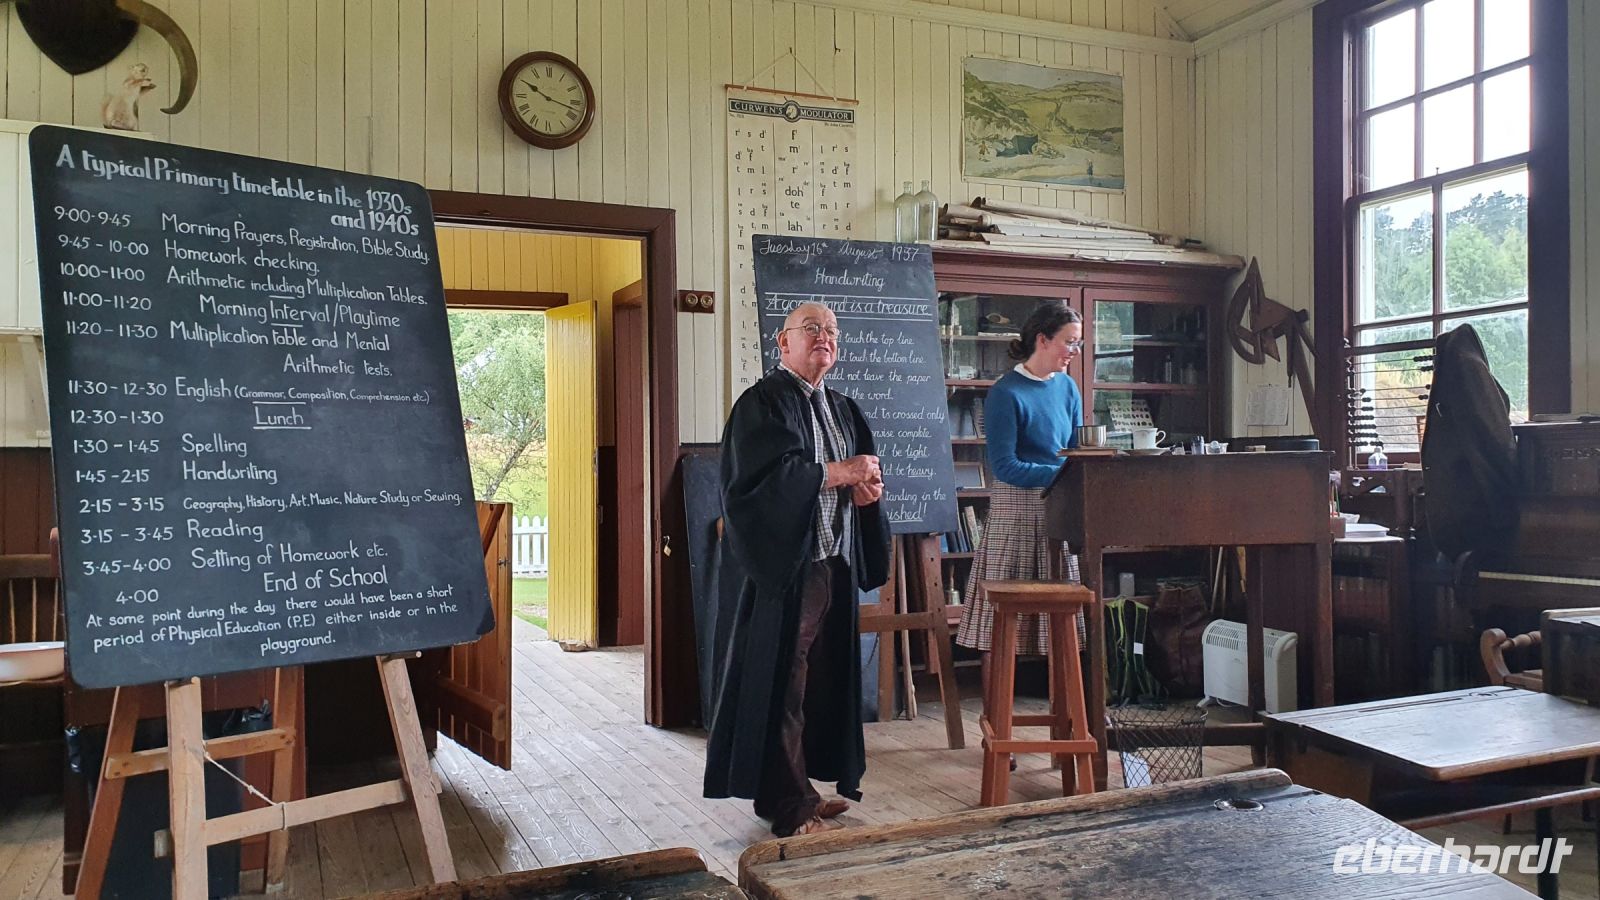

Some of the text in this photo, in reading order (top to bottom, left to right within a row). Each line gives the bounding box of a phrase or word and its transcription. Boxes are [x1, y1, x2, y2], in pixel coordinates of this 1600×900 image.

[735, 102, 848, 120] CURWEN'S MODULATOR
[56, 144, 413, 215] A typical Primary timetable in the 1930s
[331, 210, 419, 235] and 1940s
[787, 220, 803, 232] lah
[162, 212, 231, 243] Morning
[234, 221, 287, 247] Prayers,
[289, 228, 359, 254] Registration,
[362, 237, 393, 256] Bible
[395, 241, 430, 265] Study.
[164, 238, 248, 266] Homework
[253, 249, 320, 276] checking.
[760, 239, 810, 264] Tuesday
[839, 243, 880, 264] August
[166, 265, 246, 290] Arithmetic
[251, 274, 305, 298] including
[307, 278, 385, 303] Multiplication
[386, 285, 428, 305] Tables.
[814, 267, 885, 292] Handwriting
[199, 294, 268, 324] Morning
[765, 294, 778, 310] A
[850, 299, 862, 312] is
[864, 302, 874, 313] a
[876, 299, 930, 315] treasure
[170, 320, 269, 348] Multiplication
[272, 327, 308, 347] table
[311, 330, 338, 348] and
[346, 331, 390, 351] Mental
[845, 331, 864, 343] touch
[865, 331, 879, 344] the
[880, 333, 894, 347] top
[283, 353, 393, 376] Arithmetic tests.
[849, 349, 867, 362] touch
[869, 350, 881, 363] the
[883, 350, 908, 363] bottom
[847, 370, 860, 381] not
[863, 368, 884, 380] leave
[889, 369, 902, 382] the
[907, 375, 931, 384] paper
[175, 376, 231, 402] English
[350, 389, 411, 404] Comprehension
[852, 387, 865, 400] the
[255, 406, 304, 426] Lunch
[892, 406, 924, 419] crossed
[926, 406, 945, 423] only
[181, 432, 248, 458] Spelling
[892, 444, 902, 457] be
[182, 460, 278, 485] Handwriting
[896, 464, 906, 476] be
[344, 490, 378, 505] Nature
[379, 489, 410, 507] Study
[411, 493, 423, 502] or
[424, 488, 462, 506] Sewing.
[921, 490, 931, 500] in
[933, 488, 947, 500] the
[187, 518, 264, 542] Reading
[191, 547, 251, 572] Setting
[257, 543, 274, 565] of
[280, 539, 360, 563] Homework
[366, 542, 388, 558] etc.
[263, 571, 298, 593] End
[305, 569, 323, 590] of
[329, 565, 389, 588] School
[86, 614, 103, 629] At
[109, 613, 145, 626] some
[152, 608, 182, 626] point
[187, 606, 225, 623] during
[229, 602, 248, 616] the
[254, 600, 276, 615] day
[286, 597, 318, 611] there
[324, 593, 355, 608] would
[360, 591, 386, 604] have
[389, 588, 413, 601] been
[426, 584, 454, 598] short
[93, 630, 144, 654] period
[151, 627, 169, 642] of
[168, 621, 222, 645] Physical
[225, 620, 282, 636] Education
[325, 611, 363, 626] either
[369, 606, 401, 620] inside
[407, 606, 420, 617] or
[426, 604, 437, 615] in
[440, 601, 458, 614] the
[261, 631, 336, 656] playground.
